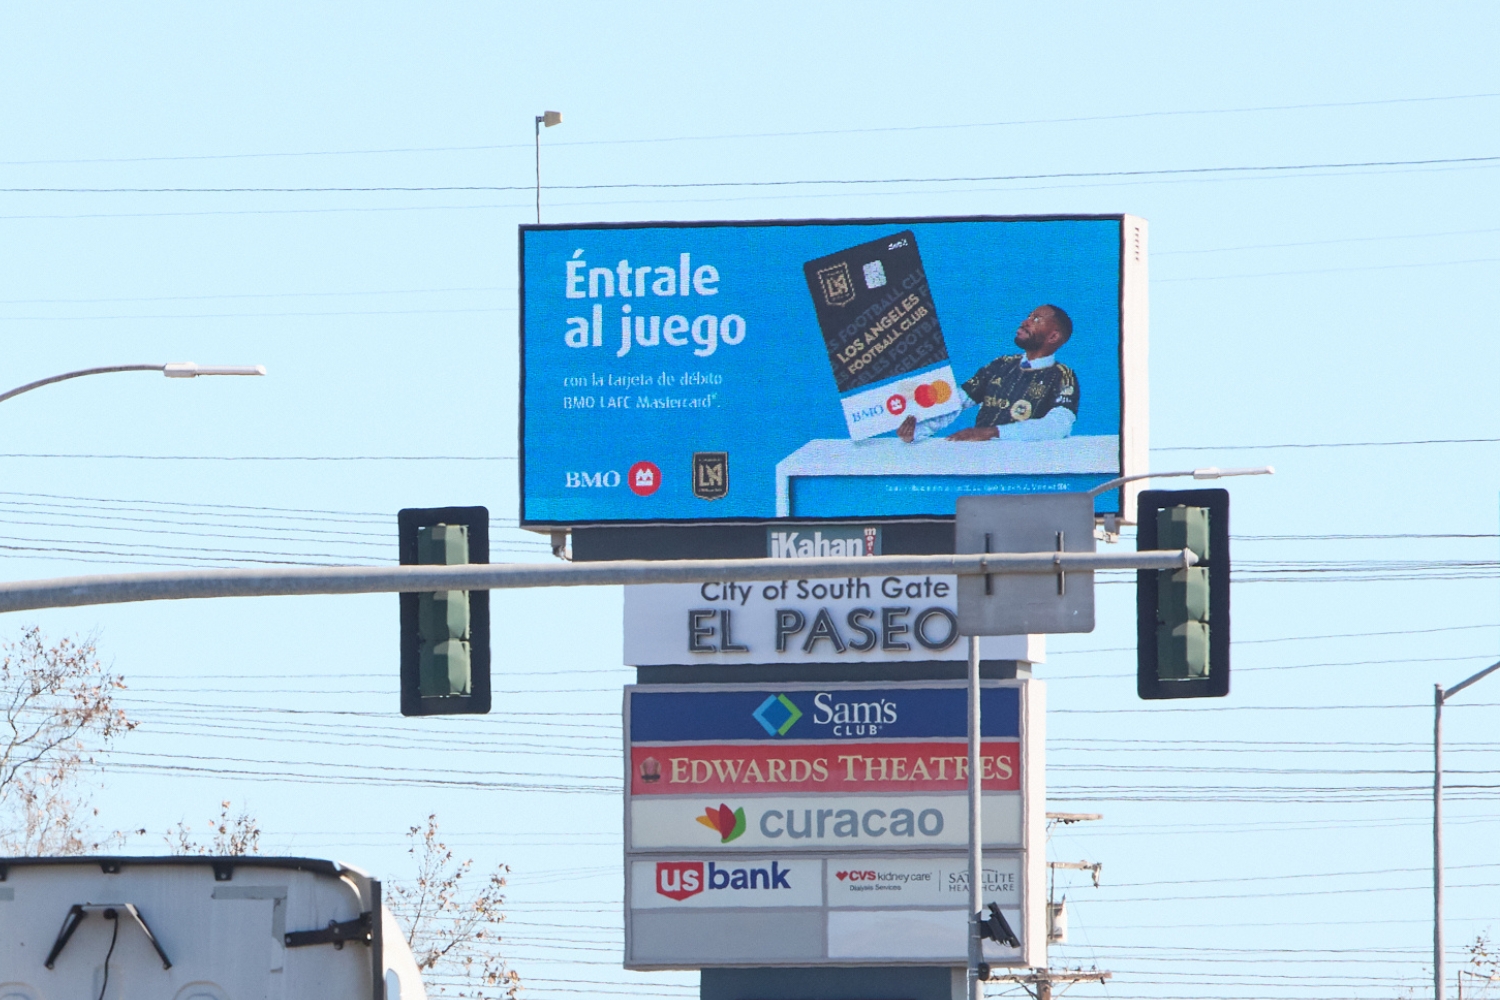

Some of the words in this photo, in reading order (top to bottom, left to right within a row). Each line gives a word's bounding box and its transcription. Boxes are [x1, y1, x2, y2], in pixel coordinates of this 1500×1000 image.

[565, 248, 721, 299] Éntrale
[564, 303, 603, 348] al
[616, 303, 747, 358] juego
[836, 337, 866, 364] LOS
[863, 293, 921, 346] ANGELES
[847, 328, 903, 375] FOOTBALL
[899, 306, 929, 331] CLUB
[564, 375, 587, 387] con
[592, 372, 604, 386] la
[608, 372, 654, 390] tarjeta
[657, 371, 675, 386] de
[679, 371, 723, 386] débito
[563, 396, 596, 409] BMO
[852, 404, 885, 423] BMO
[565, 470, 622, 488] BMO
[864, 528, 877, 557] medi
[701, 581, 752, 605] City
[762, 580, 788, 601] of
[797, 577, 871, 600] South
[881, 576, 950, 599] Gate
[688, 608, 749, 653] EL
[775, 606, 960, 654] PASEO
[813, 692, 897, 725] Sam's
[669, 757, 829, 785] EDWARDS
[838, 755, 1013, 782] THEATRES
[760, 807, 945, 839] curacao
[660, 869, 700, 892] us
[707, 860, 792, 890] bank
[849, 870, 876, 882] CVS
[877, 871, 910, 884] kidney
[910, 872, 932, 882] care
[849, 884, 874, 892] Dialysis
[875, 883, 902, 892] Services
[948, 870, 1015, 884] SATLLITE
[948, 883, 1015, 892] HEAHCARE
